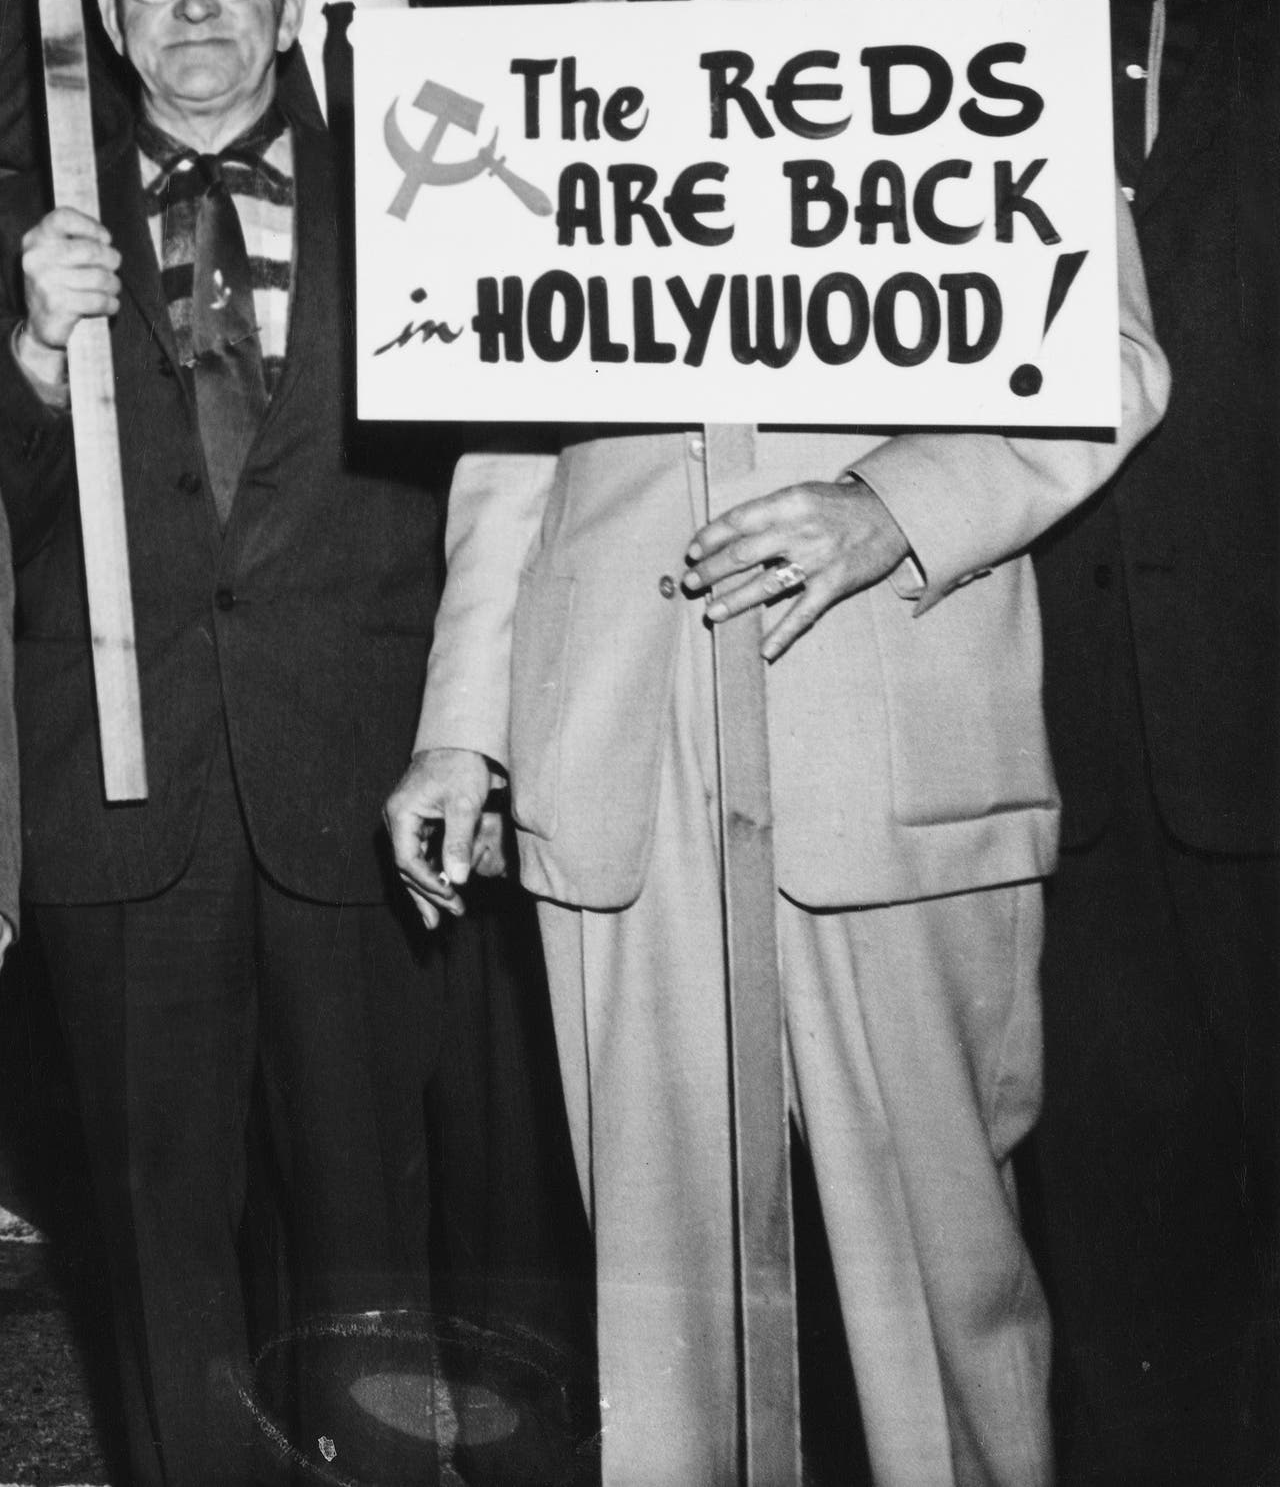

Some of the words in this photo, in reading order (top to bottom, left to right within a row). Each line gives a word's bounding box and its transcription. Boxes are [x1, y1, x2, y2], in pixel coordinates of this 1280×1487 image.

[510, 56, 648, 141] The
[700, 43, 1044, 140] REDS
[555, 161, 734, 247] ARE
[783, 158, 1061, 247] BACK
[373, 287, 463, 356] in
[472, 250, 1088, 397] HOLLYWOOD!
